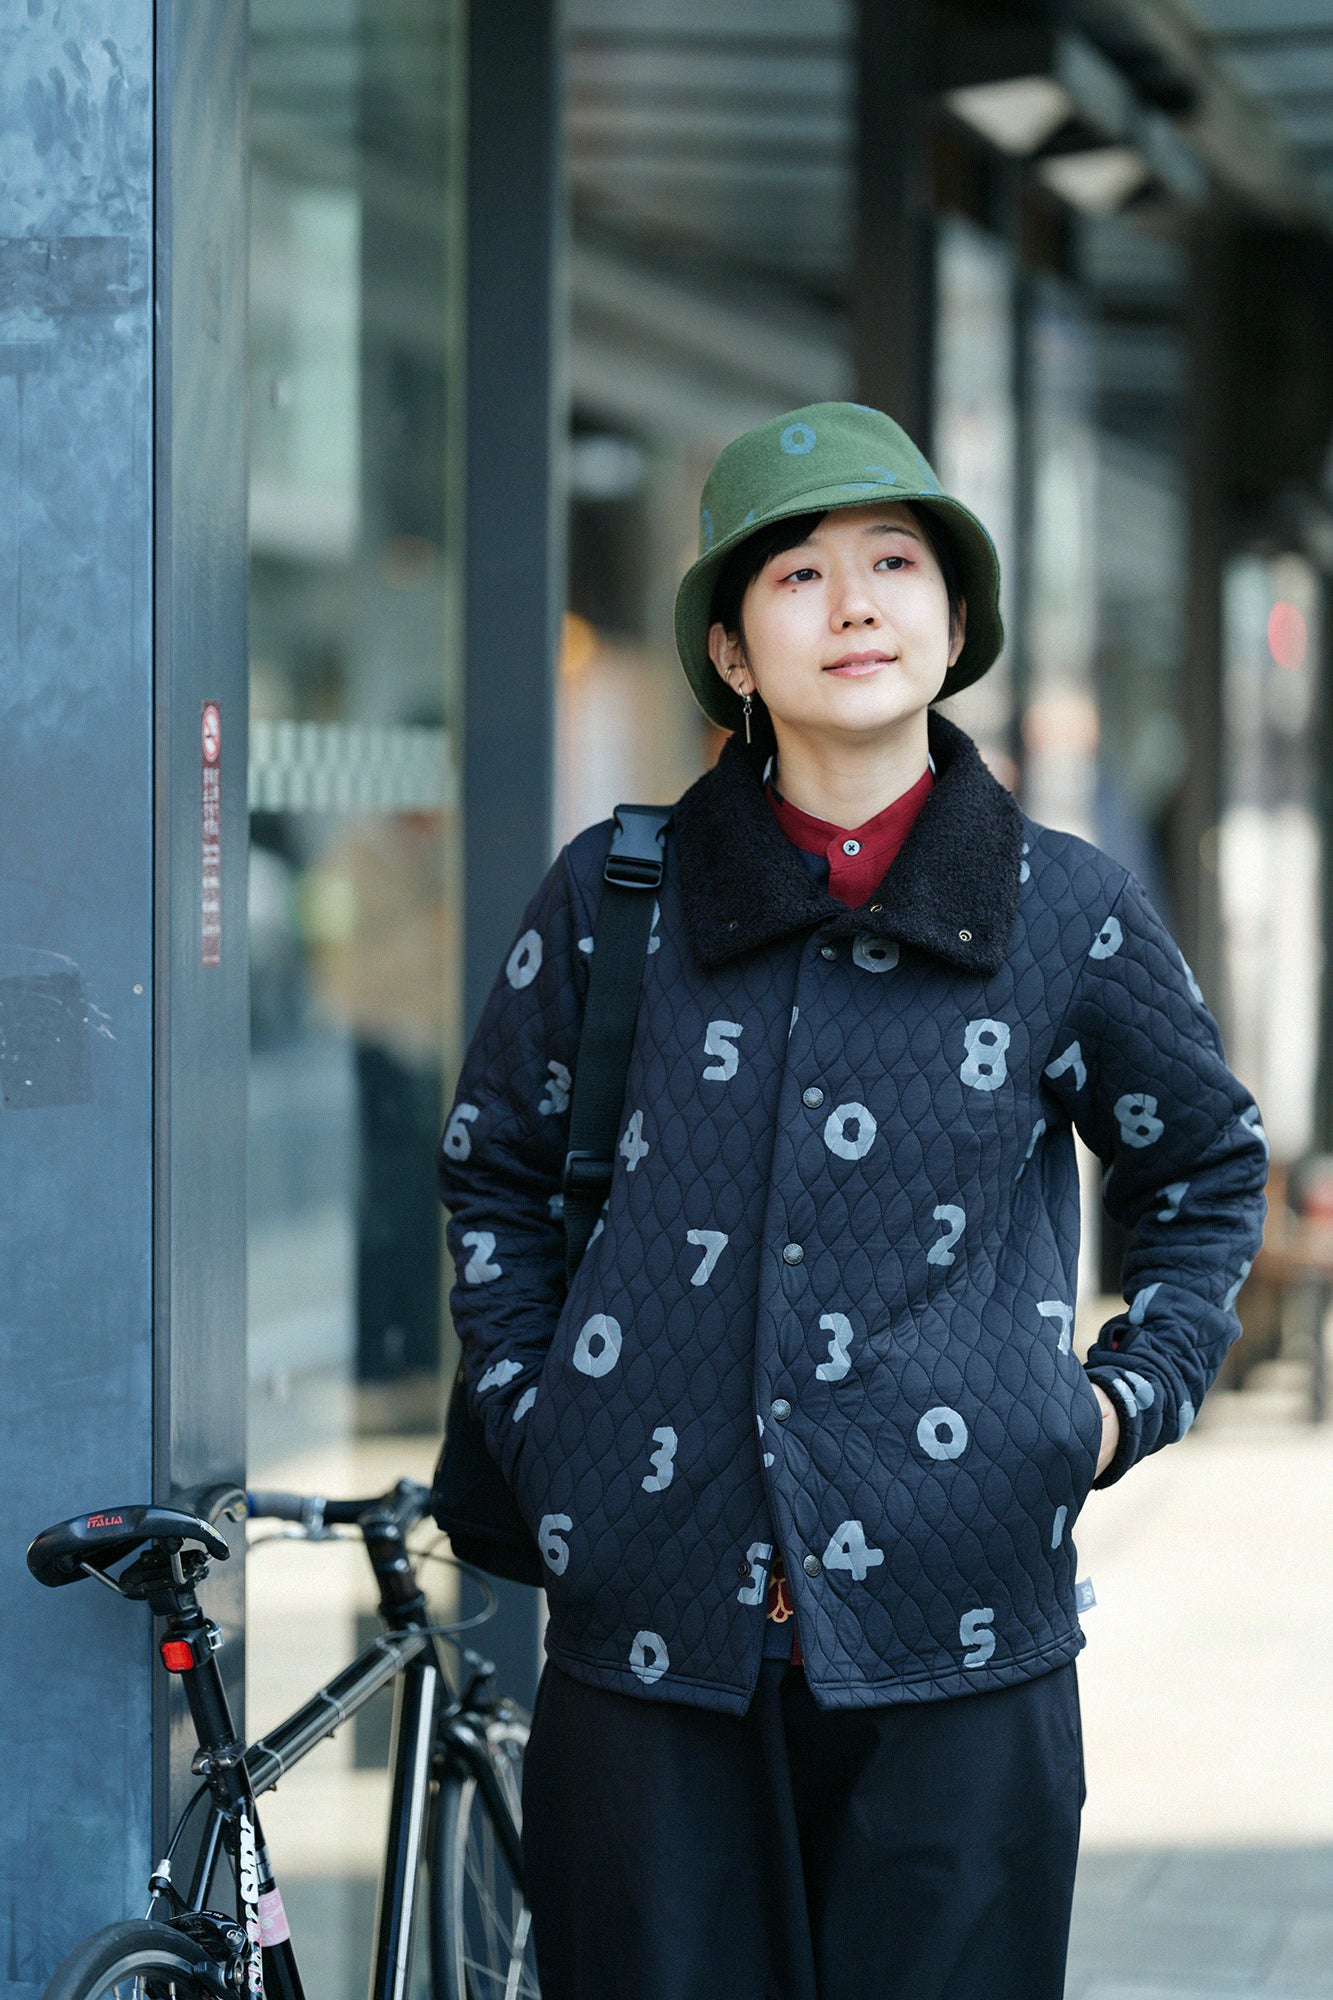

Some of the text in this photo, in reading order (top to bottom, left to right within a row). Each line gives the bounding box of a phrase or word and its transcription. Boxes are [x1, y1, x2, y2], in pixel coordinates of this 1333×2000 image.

[780, 423, 816, 455] 0
[506, 929, 543, 989] 0
[703, 1020, 744, 1081] 5
[960, 1018, 1010, 1092] 8
[444, 1103, 480, 1162] 6
[619, 1110, 649, 1172] 4
[824, 1102, 877, 1161] 0
[1114, 1093, 1165, 1148] 8
[462, 1230, 502, 1284] 2
[687, 1228, 728, 1287] 7
[926, 1204, 967, 1266] 2
[573, 1313, 623, 1378] 0
[816, 1312, 853, 1382] 3
[641, 1426, 678, 1493] 3
[917, 1406, 968, 1460] 0
[87, 1515, 123, 1528] ITALIA
[538, 1513, 573, 1576] 6
[822, 1520, 885, 1582] 4
[629, 1630, 670, 1684] 0
[959, 1607, 996, 1668] 5
